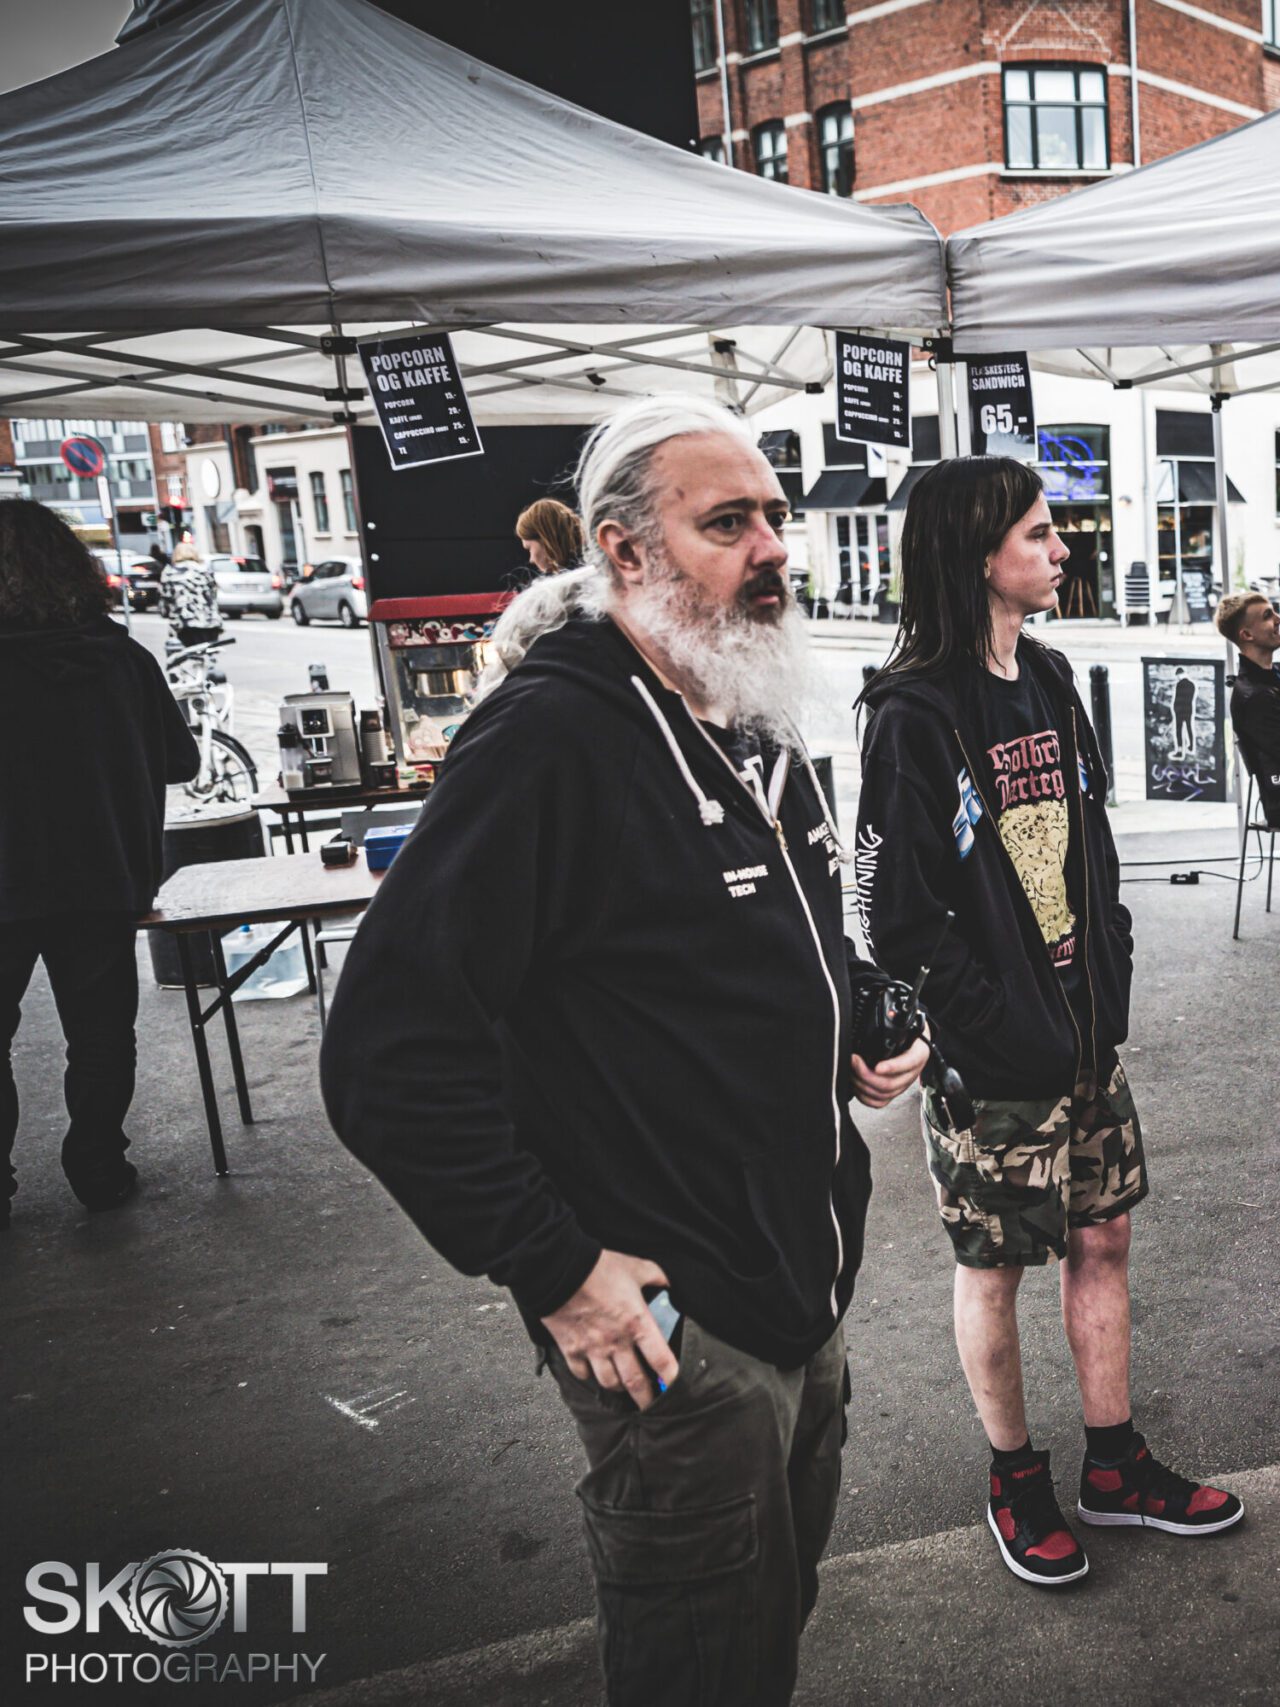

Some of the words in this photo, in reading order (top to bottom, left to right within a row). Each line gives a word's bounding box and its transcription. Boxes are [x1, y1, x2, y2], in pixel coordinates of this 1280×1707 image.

[370, 346, 446, 372] POPCORN
[843, 344, 902, 367] POPCORN
[376, 373, 402, 392] OG
[402, 365, 452, 388] KAFFE
[843, 360, 861, 377] OG
[864, 363, 902, 384] KAFFE
[972, 374, 1025, 391] SANDWICH
[981, 403, 1027, 435] 65,-
[723, 864, 768, 883] IN-HOUSE
[728, 882, 756, 898] TECH
